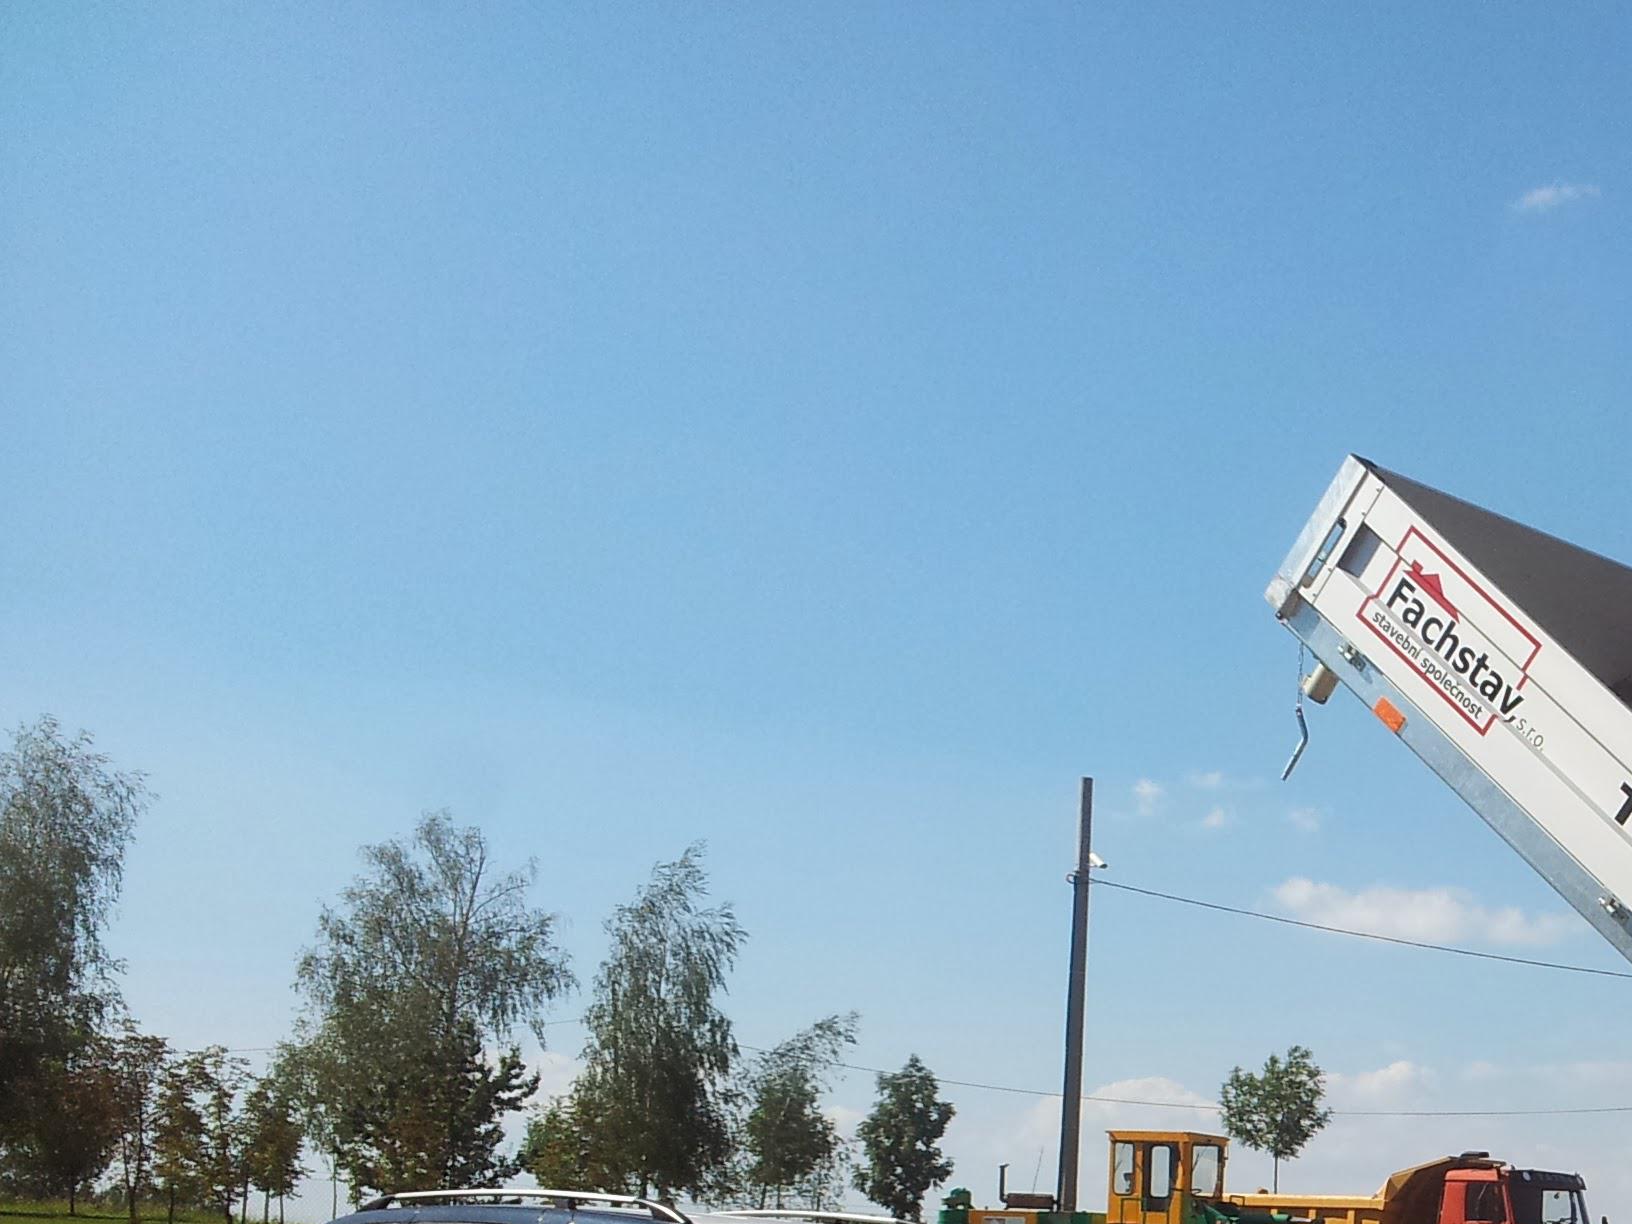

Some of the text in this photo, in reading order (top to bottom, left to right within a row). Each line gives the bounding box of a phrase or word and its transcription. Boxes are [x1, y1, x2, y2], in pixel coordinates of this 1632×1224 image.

[1372, 611, 1484, 720] stavební společnost
[1515, 718, 1545, 751] s.r.o.
